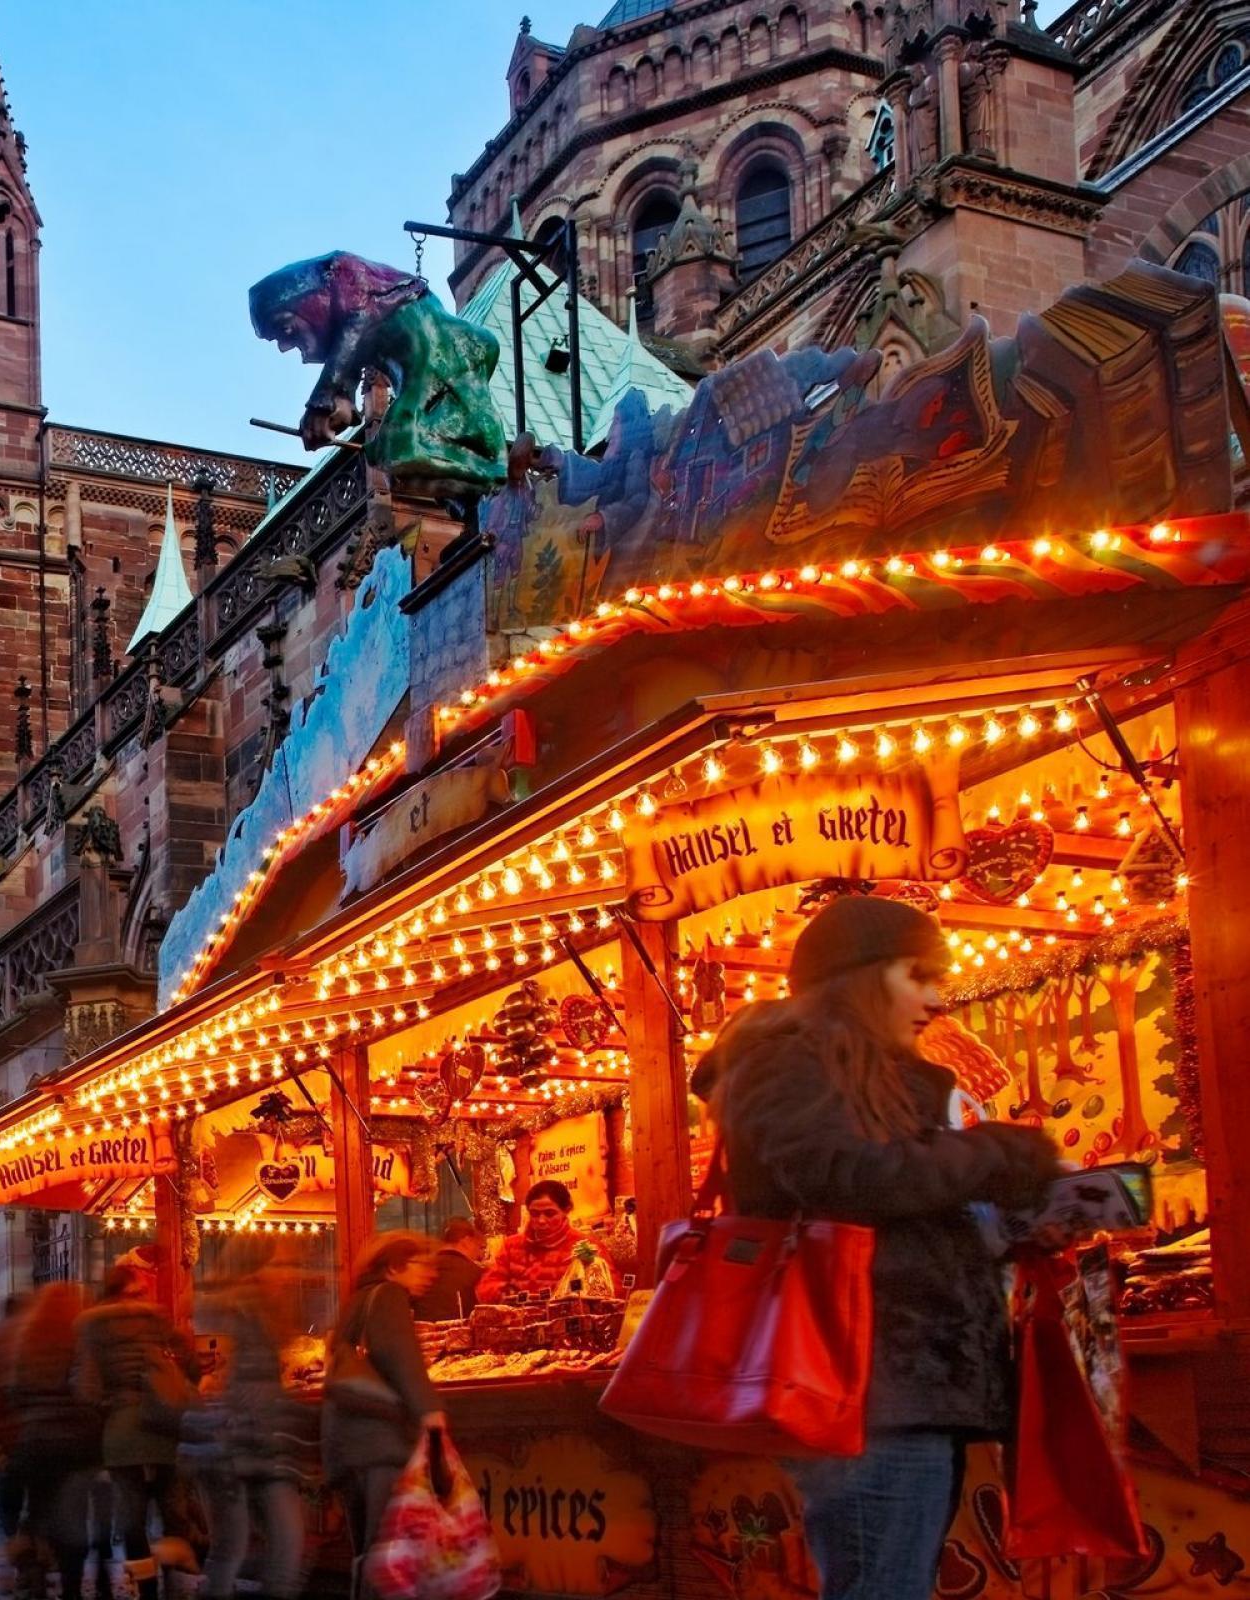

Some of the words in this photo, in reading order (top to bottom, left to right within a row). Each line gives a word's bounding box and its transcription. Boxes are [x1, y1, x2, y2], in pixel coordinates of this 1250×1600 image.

[409, 791, 431, 834] et
[771, 811, 795, 847] et
[70, 1147, 85, 1168] et
